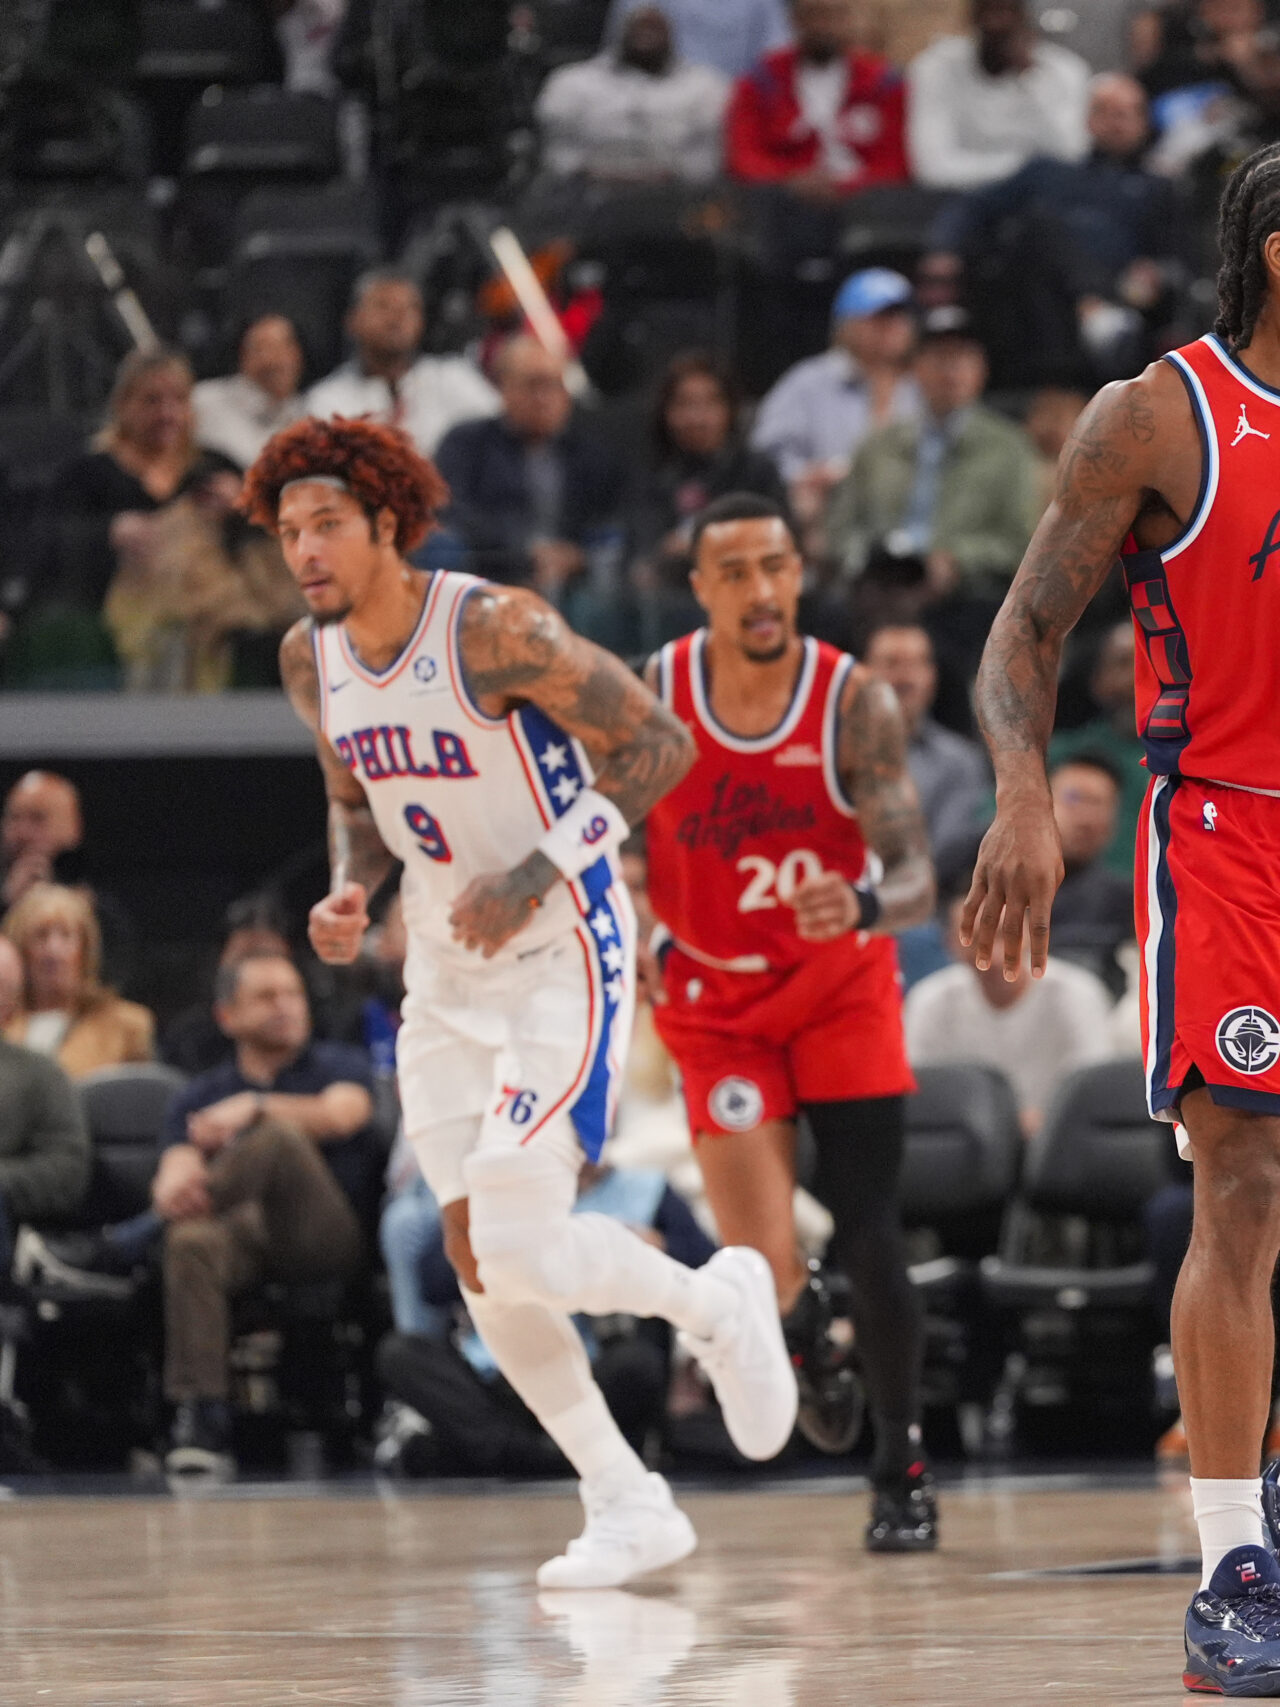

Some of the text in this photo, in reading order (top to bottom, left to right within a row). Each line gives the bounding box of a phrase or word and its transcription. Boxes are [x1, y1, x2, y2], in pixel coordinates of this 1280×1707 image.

[335, 725, 479, 781] PHILA
[404, 804, 453, 863] 9
[582, 815, 608, 845] 9
[736, 848, 824, 913] 20
[494, 1084, 537, 1126] 76
